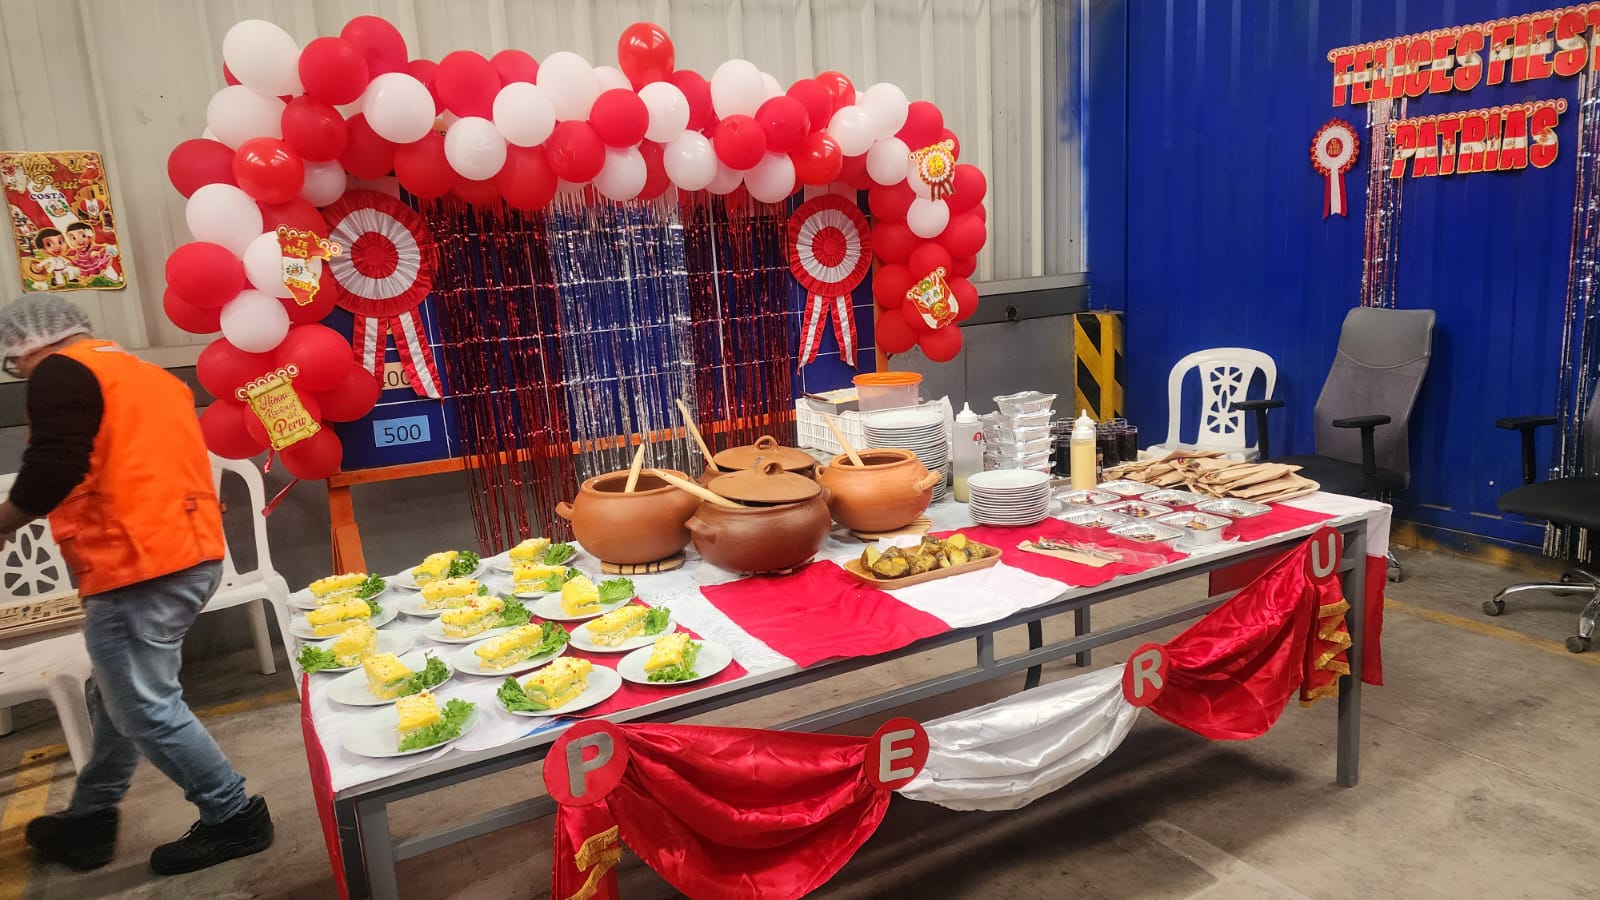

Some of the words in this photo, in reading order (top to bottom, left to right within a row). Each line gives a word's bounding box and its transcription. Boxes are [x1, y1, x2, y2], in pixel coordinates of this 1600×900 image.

[1332, 31, 1485, 107] FELICES
[1390, 107, 1559, 179] PATRIAS
[383, 369, 412, 387] 00
[384, 424, 421, 443] 500
